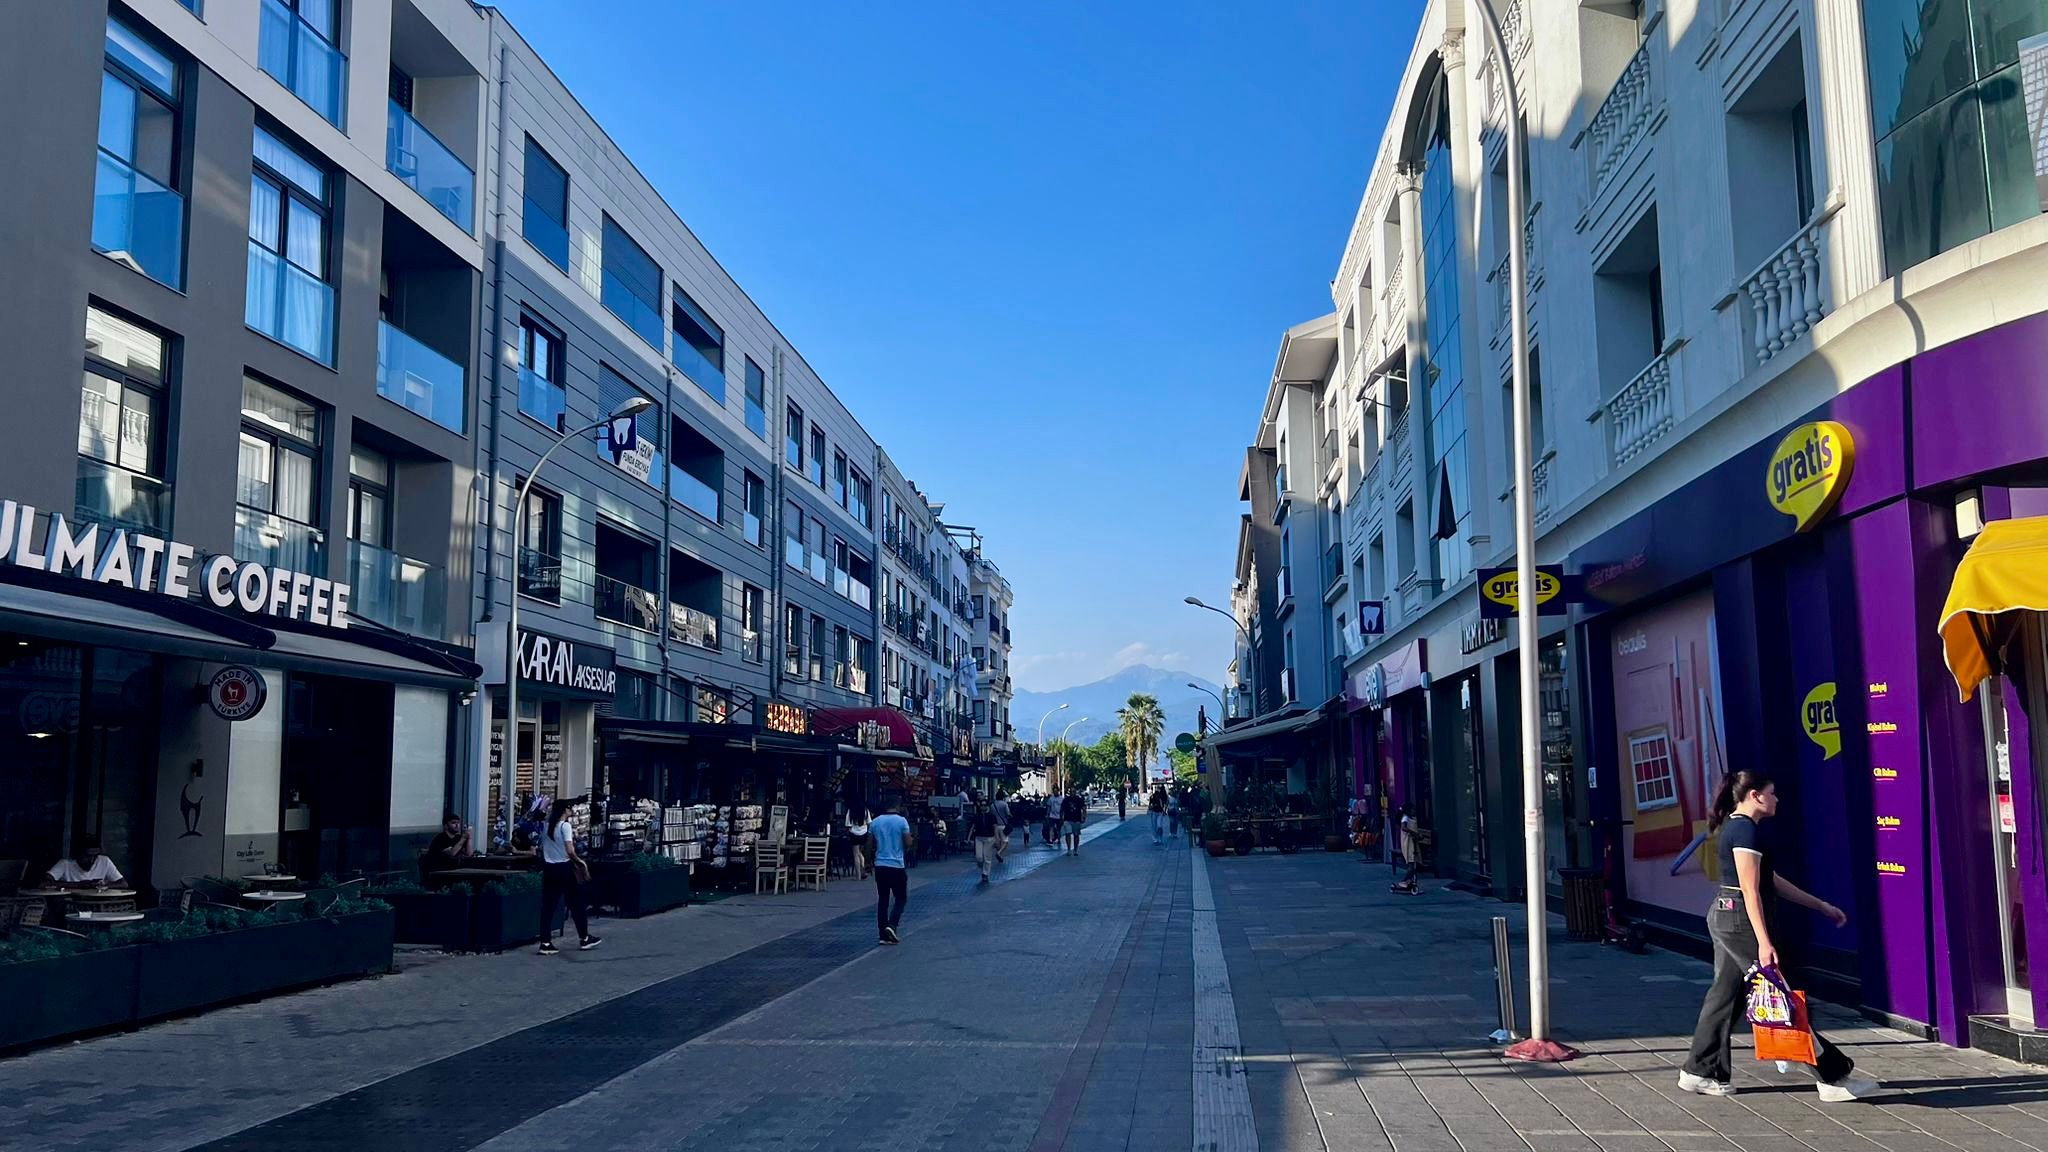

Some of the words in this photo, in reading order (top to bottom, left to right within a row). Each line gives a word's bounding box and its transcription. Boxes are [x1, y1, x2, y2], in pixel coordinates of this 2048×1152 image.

[1773, 428, 1833, 504] gratis
[202, 554, 350, 629] COFFEE
[1491, 574, 1553, 599] gris
[215, 671, 242, 688] MADE
[242, 674, 254, 686] IN
[516, 631, 573, 687] KARAN
[573, 664, 617, 694] AKSESUAR
[1807, 699, 1838, 734] gra
